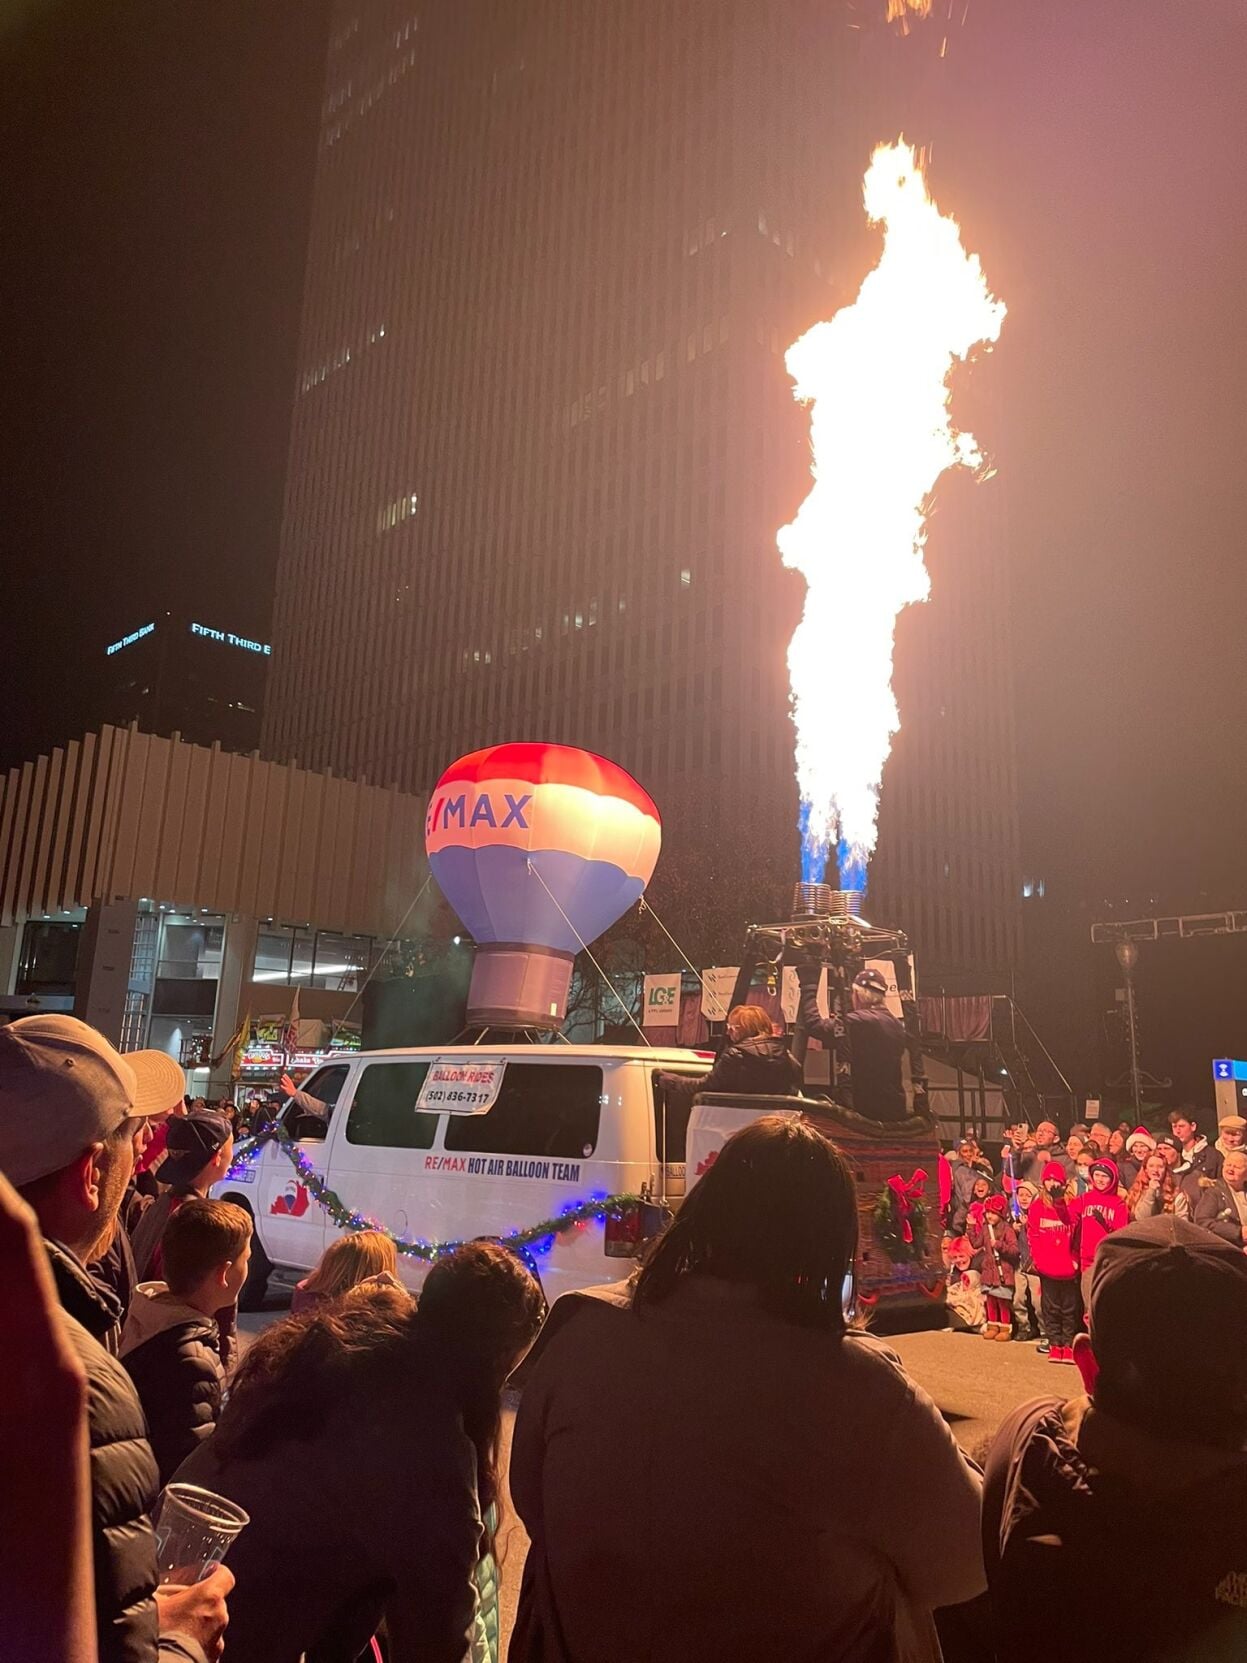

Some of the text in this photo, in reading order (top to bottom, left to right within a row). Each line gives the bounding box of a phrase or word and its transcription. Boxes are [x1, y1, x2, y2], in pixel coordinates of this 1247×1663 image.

[191, 622, 225, 641] FIFTH
[227, 633, 262, 652] THIRD
[432, 1069, 495, 1084] BALLOON RIDES
[425, 1090, 446, 1103] (502)
[424, 1155, 581, 1182] RE/MAX HOT AIR BALLOON TEAM
